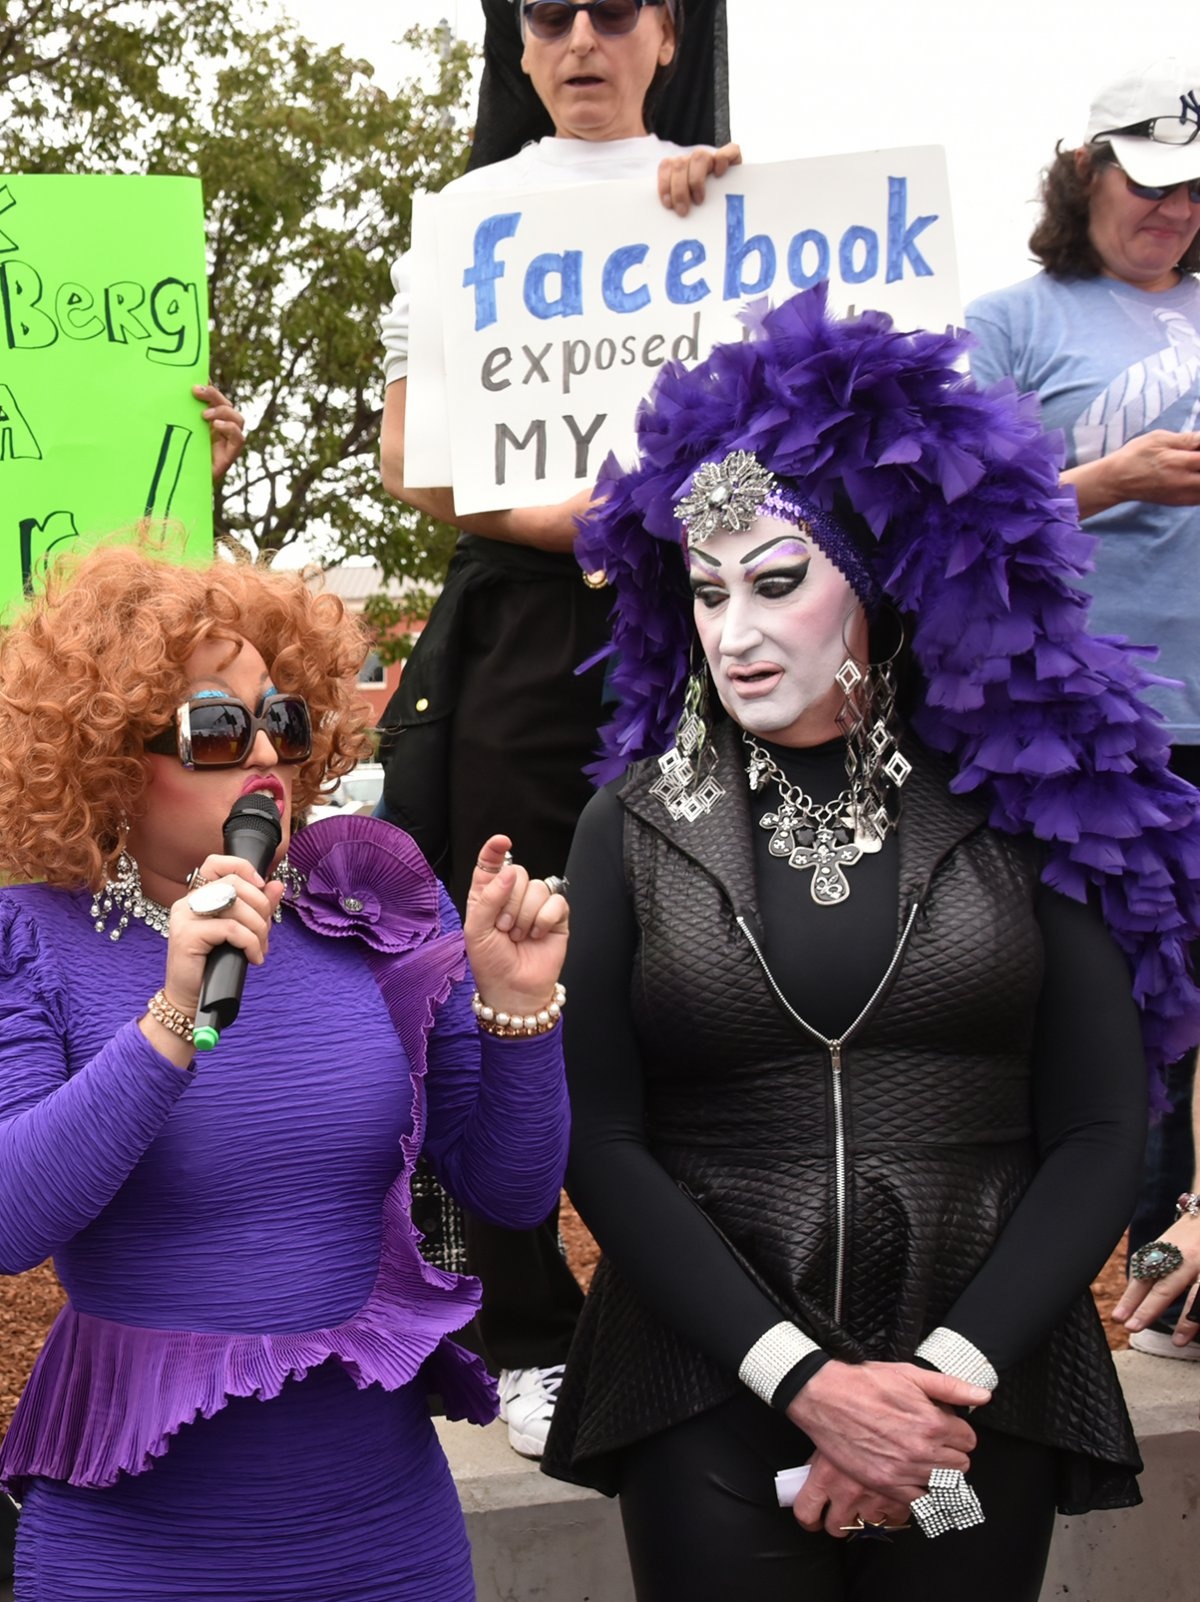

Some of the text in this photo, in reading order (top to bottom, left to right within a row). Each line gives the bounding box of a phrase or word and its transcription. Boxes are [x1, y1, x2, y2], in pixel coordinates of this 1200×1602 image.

[462, 176, 939, 332] facebook
[480, 311, 700, 395] exposed
[494, 412, 607, 486] MY
